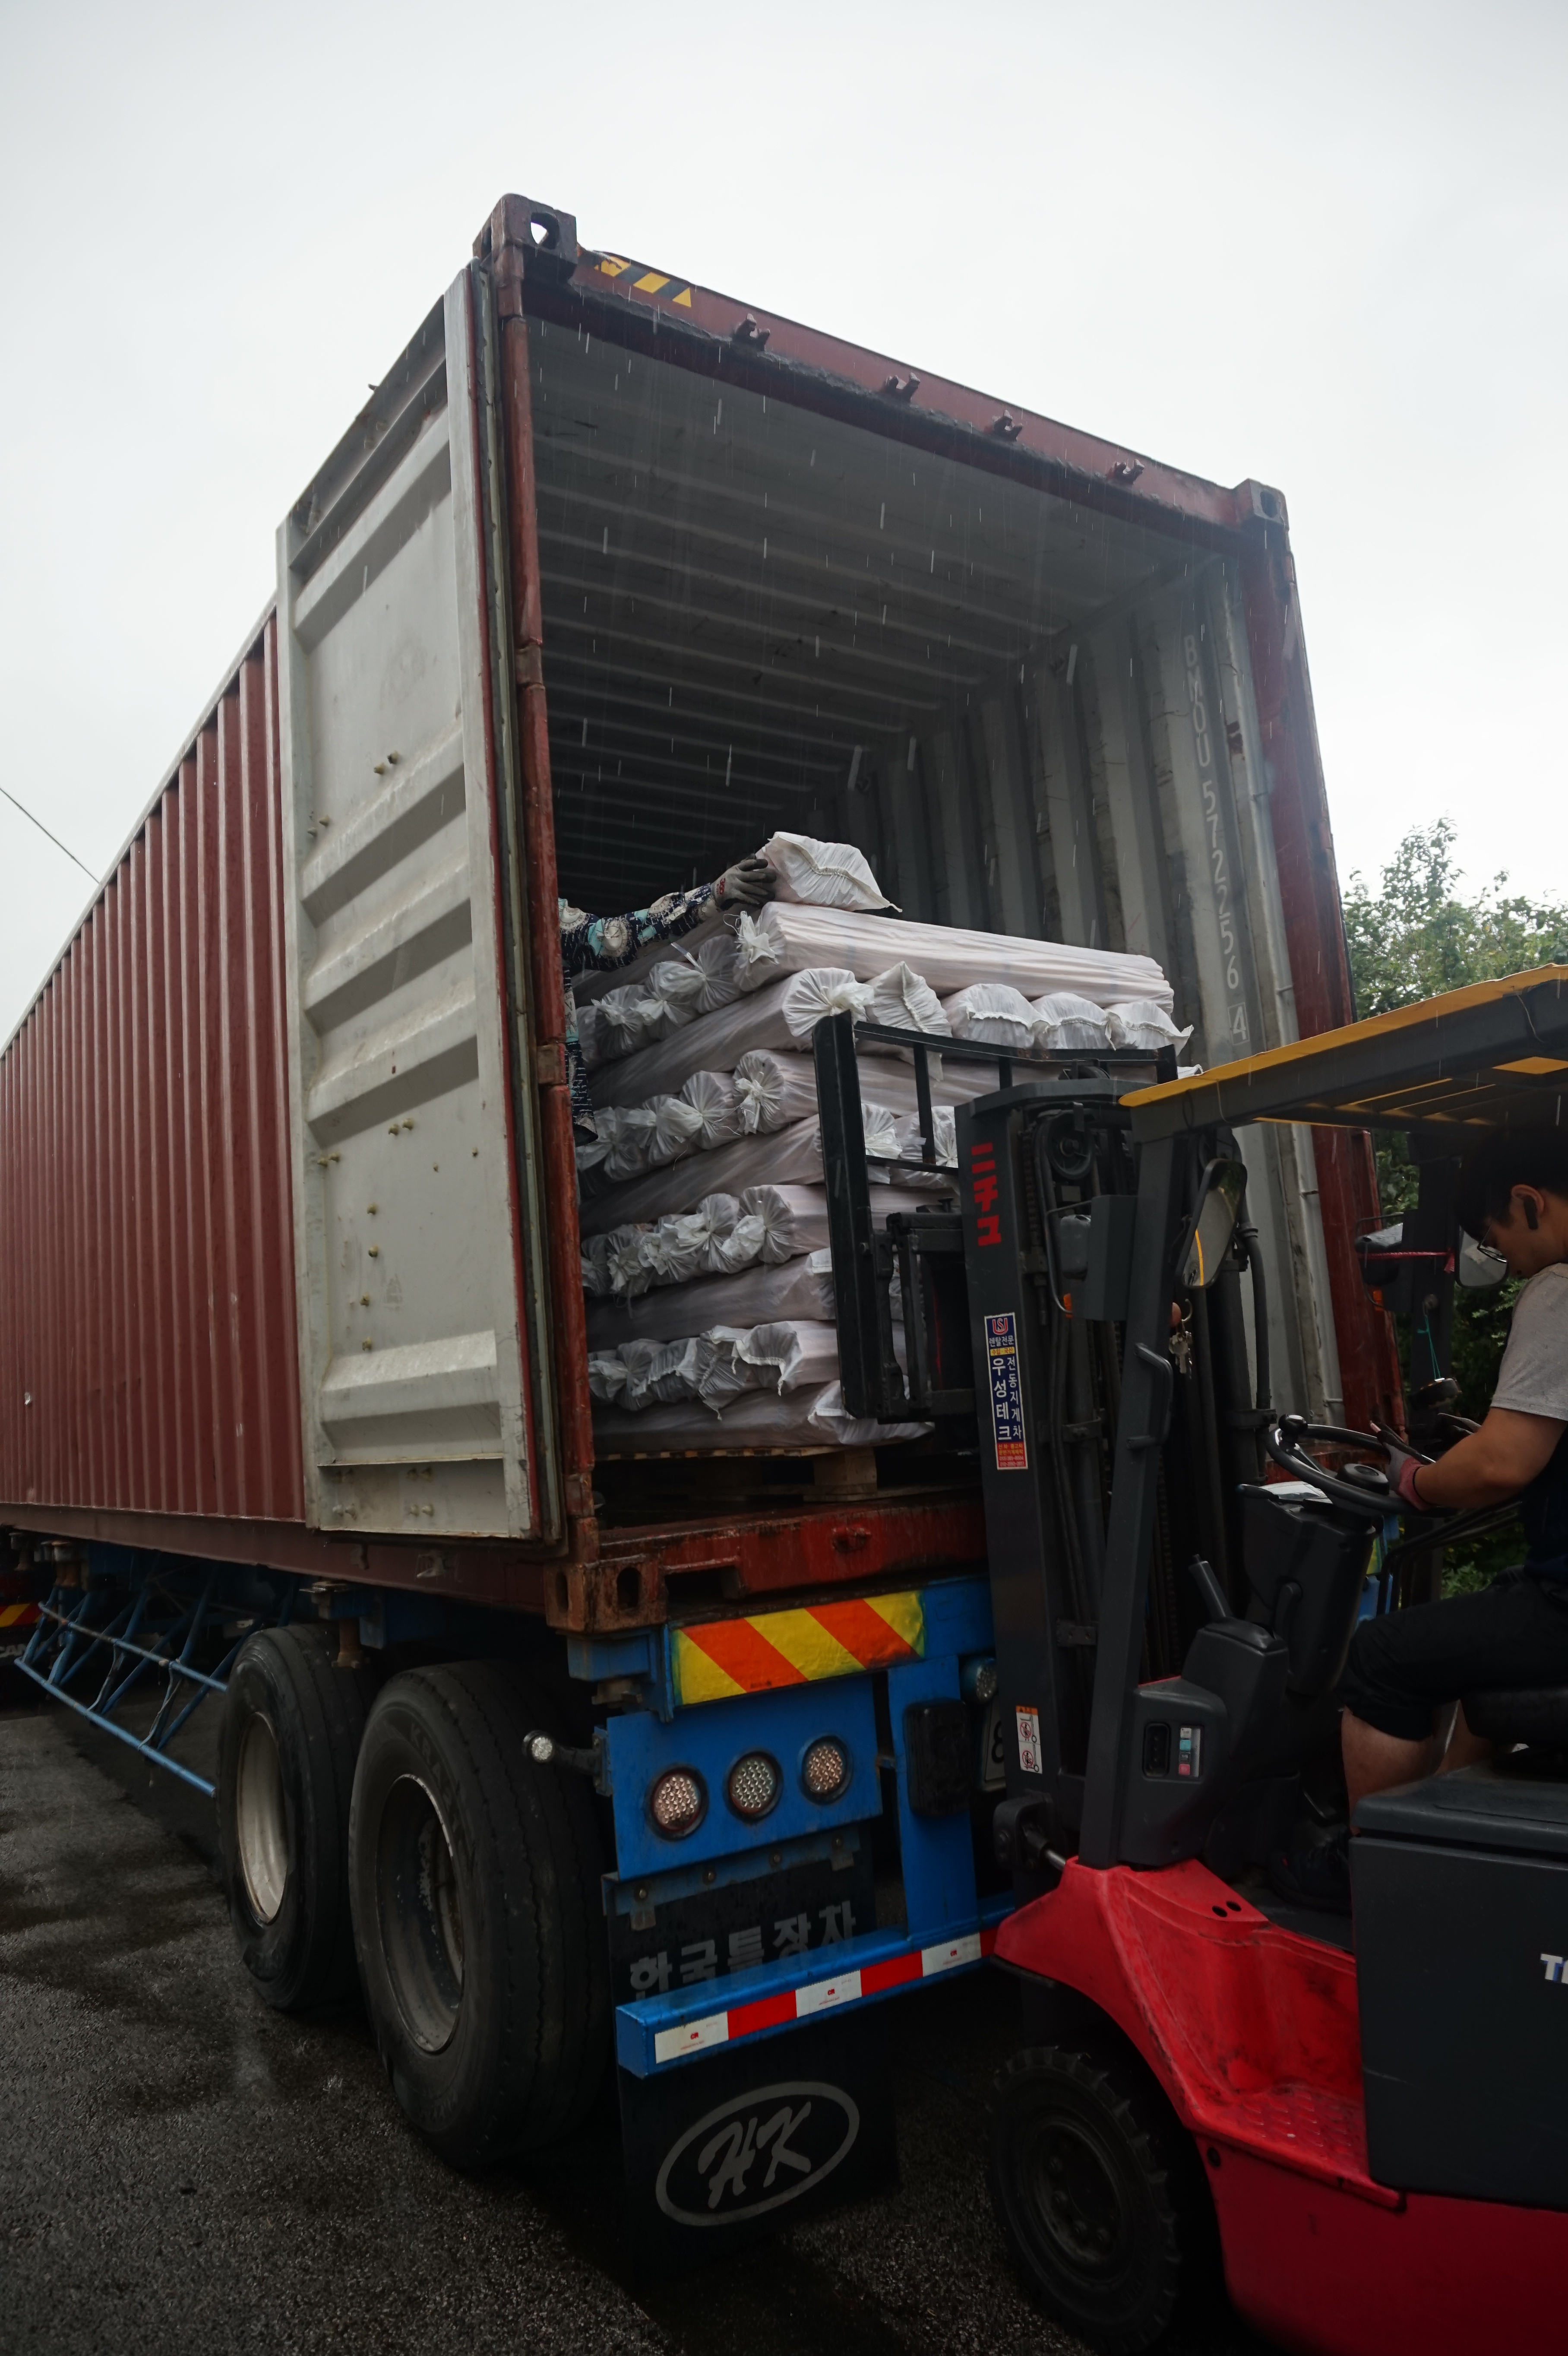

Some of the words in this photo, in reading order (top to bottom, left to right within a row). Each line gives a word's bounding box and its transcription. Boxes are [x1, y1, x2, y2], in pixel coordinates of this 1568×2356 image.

[1184, 634, 1210, 767] BMOU
[1202, 780, 1239, 989] 572256
[989, 1335, 1015, 1347] 렌탈전문
[992, 1358, 1012, 1441] 우성테크
[1007, 1356, 1022, 1440] 전동지게차
[1540, 1953, 1568, 1984] T
